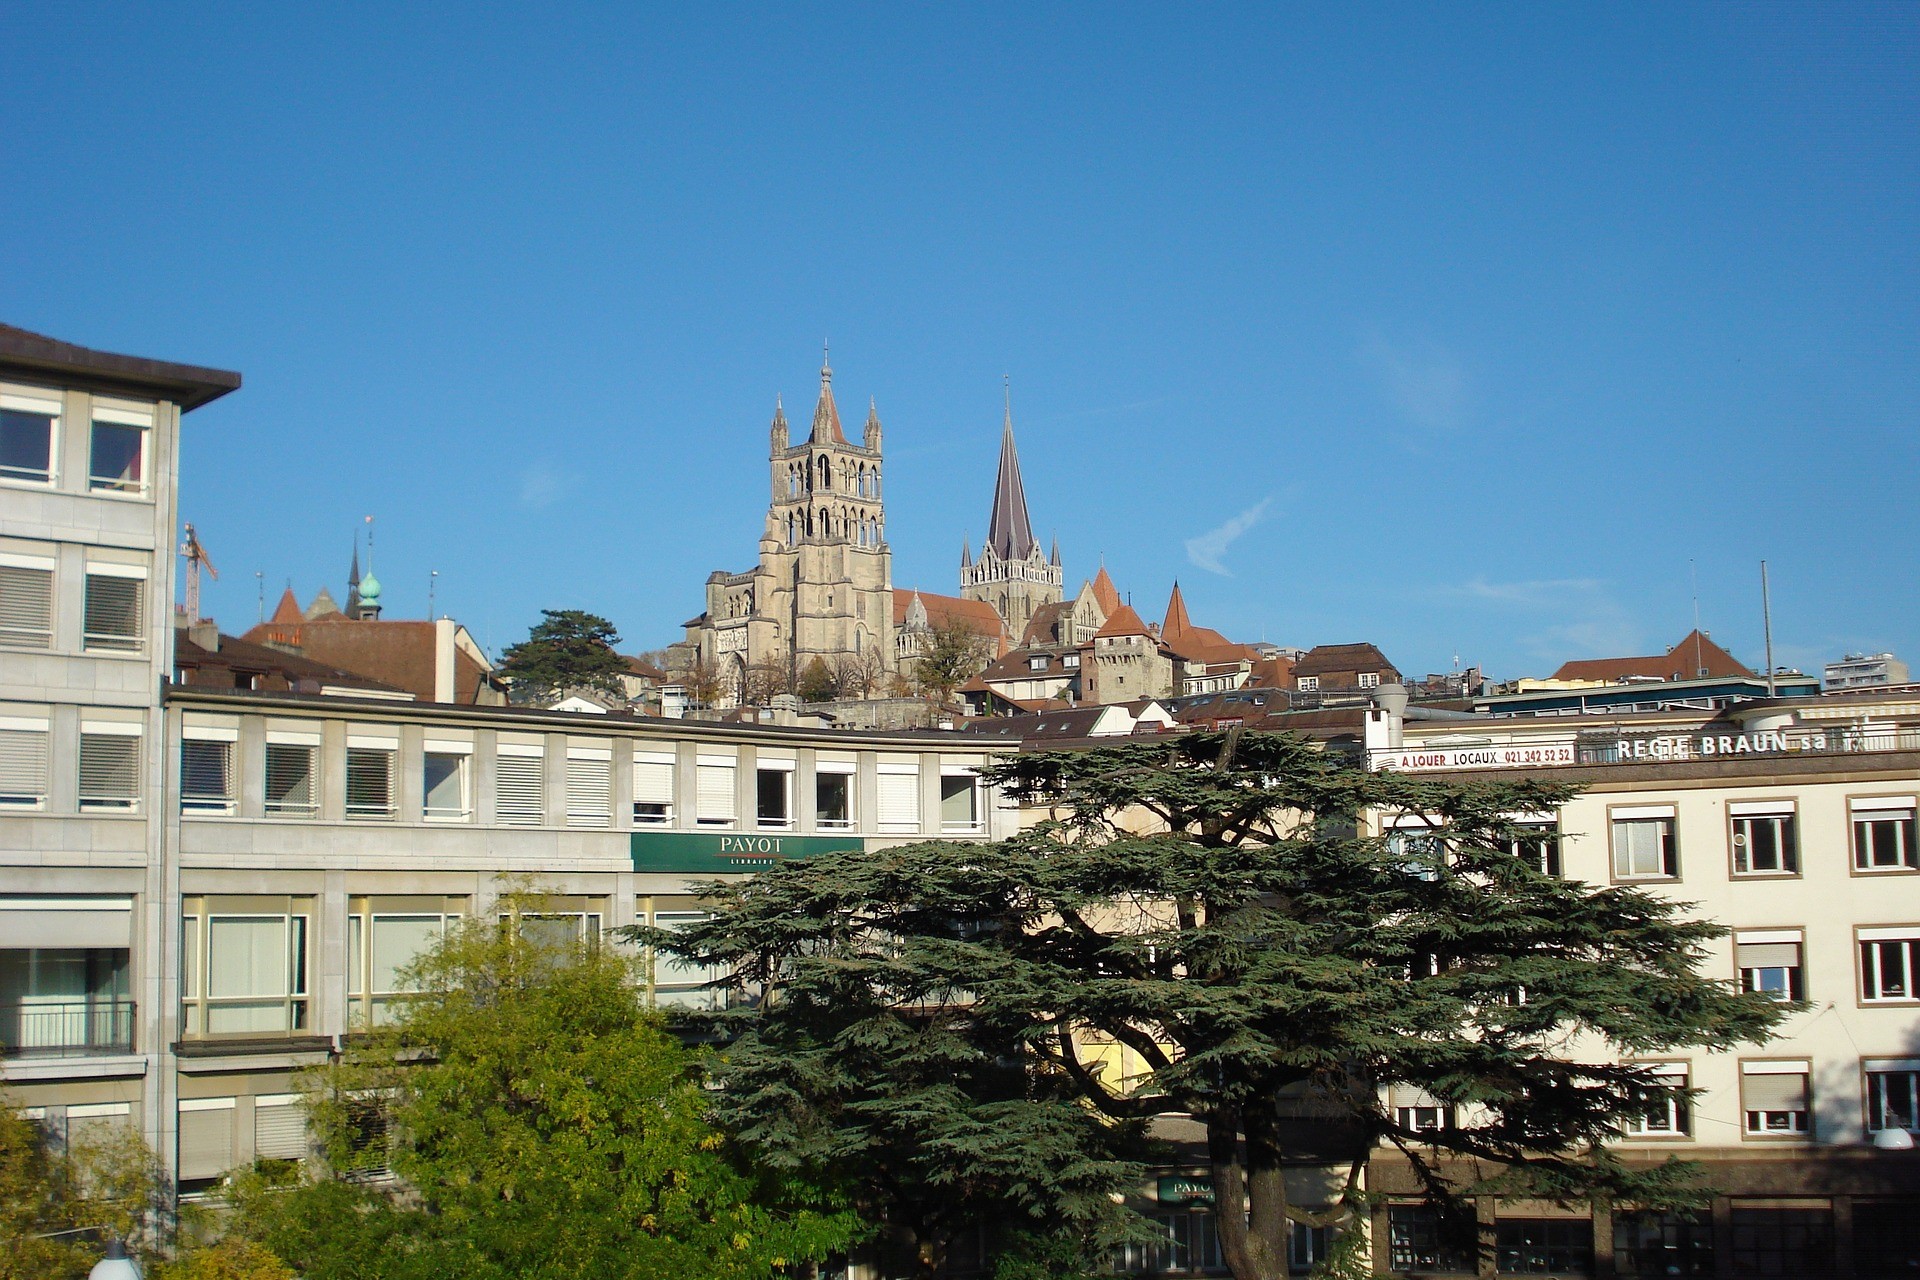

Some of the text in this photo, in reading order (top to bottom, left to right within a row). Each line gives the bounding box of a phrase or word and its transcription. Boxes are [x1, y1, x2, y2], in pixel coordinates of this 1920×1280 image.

[1617, 733, 1826, 758] REGIE BRAUN sa
[1402, 748, 1570, 767] A LOUER LOCAUX 021 342 52 52
[721, 837, 783, 853] PAYOT
[1174, 1183, 1211, 1193] PAYO
